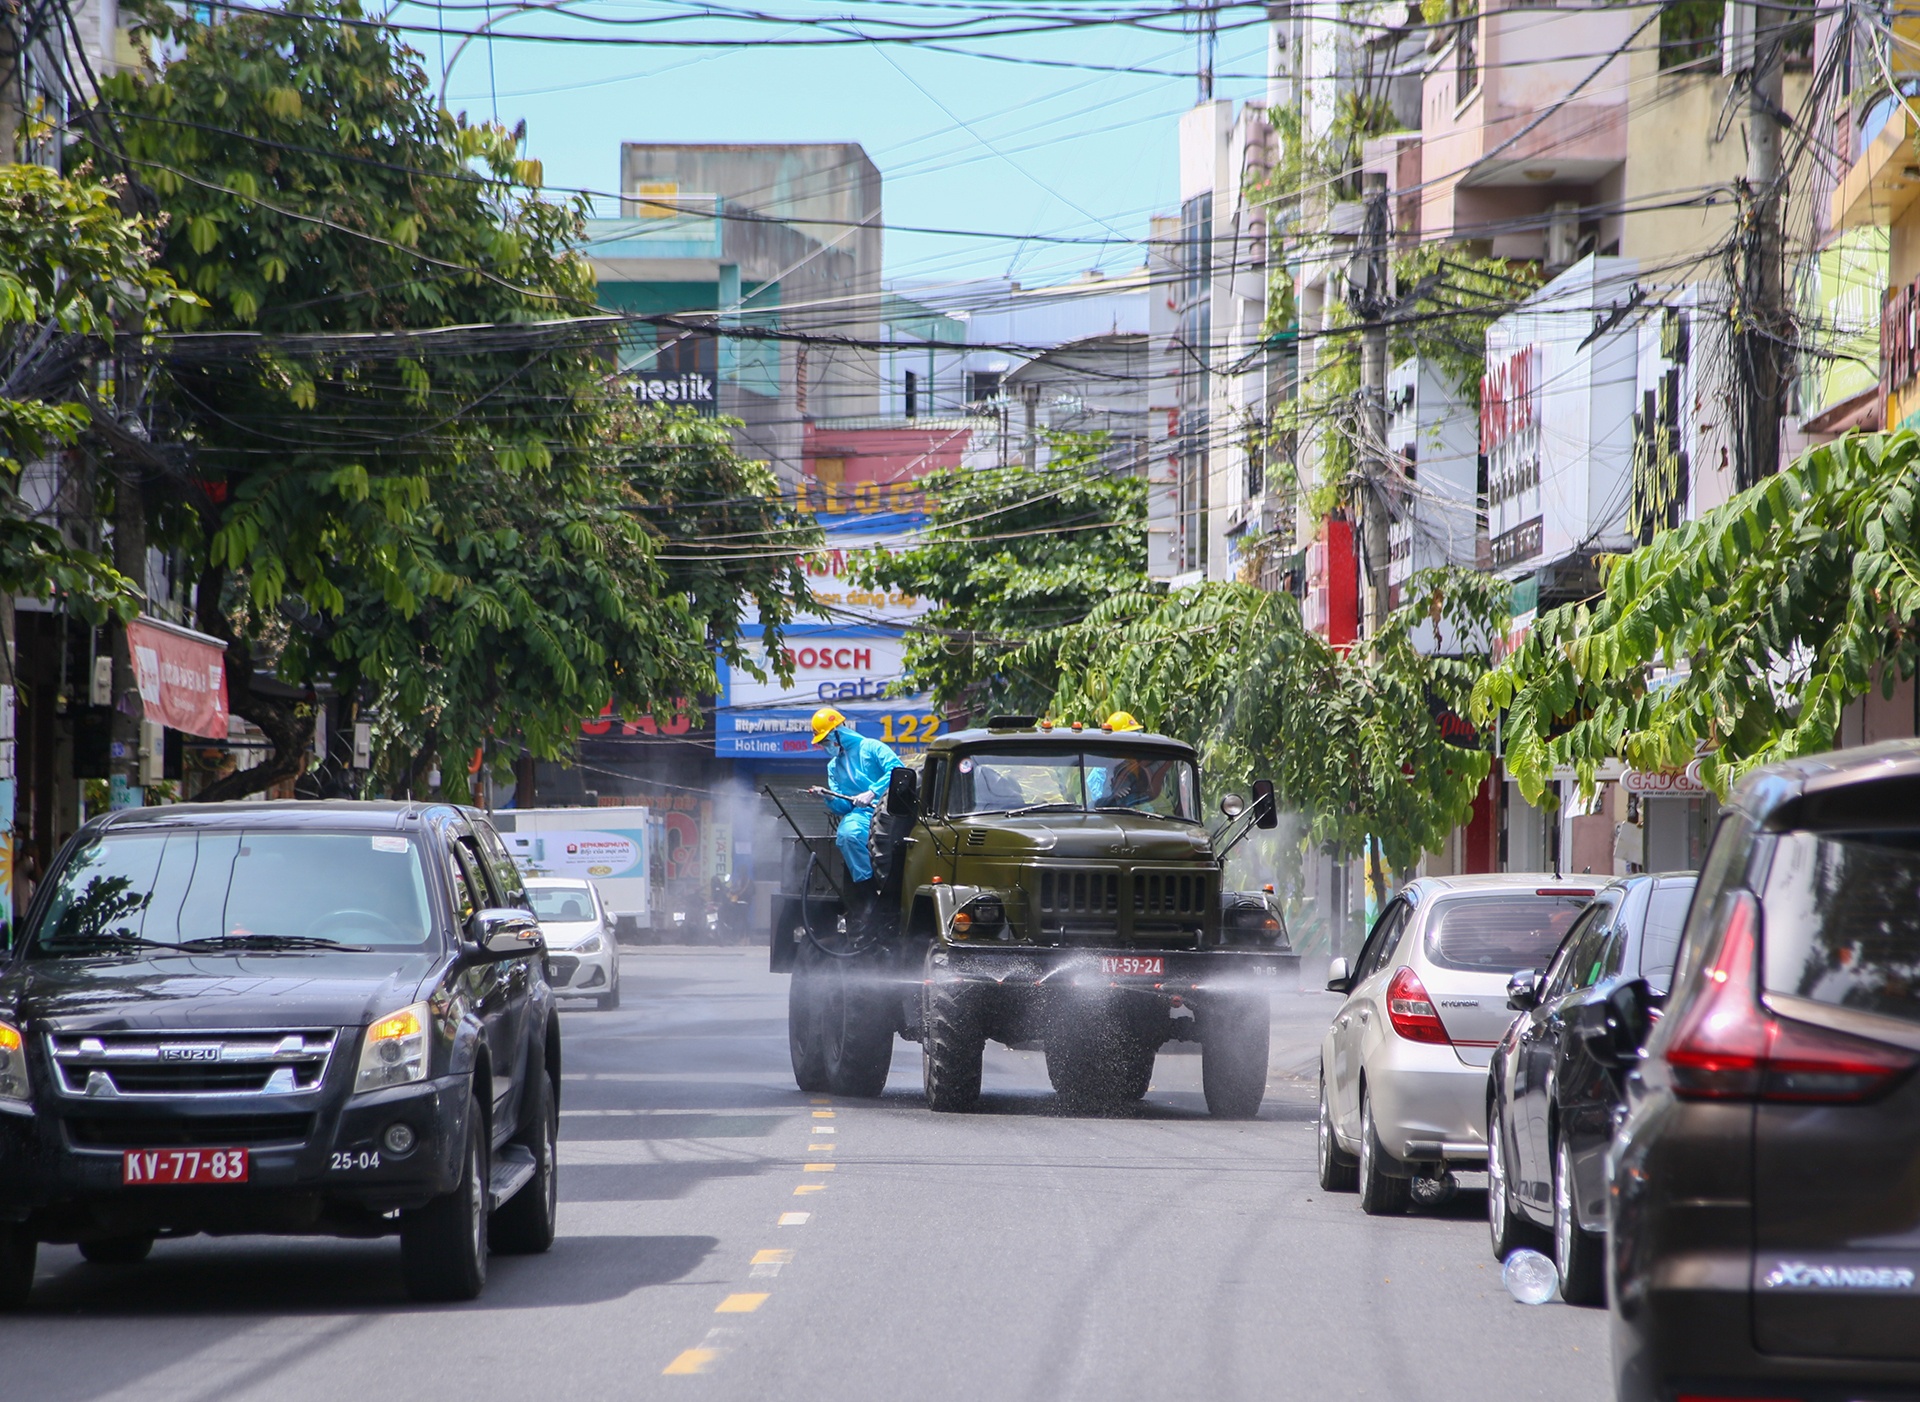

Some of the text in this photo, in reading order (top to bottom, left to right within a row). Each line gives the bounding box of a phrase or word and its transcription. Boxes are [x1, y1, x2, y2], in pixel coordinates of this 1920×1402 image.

[781, 647, 871, 670] BOSCH
[879, 714, 940, 743] 122
[735, 740, 780, 752] Hotline:
[1102, 958, 1161, 973] KV-59-24
[1440, 1000, 1479, 1008] HYUNDAI
[163, 1049, 217, 1061] ISUZU
[127, 1152, 243, 1181] KV-77-83
[331, 1152, 380, 1170] 25-04
